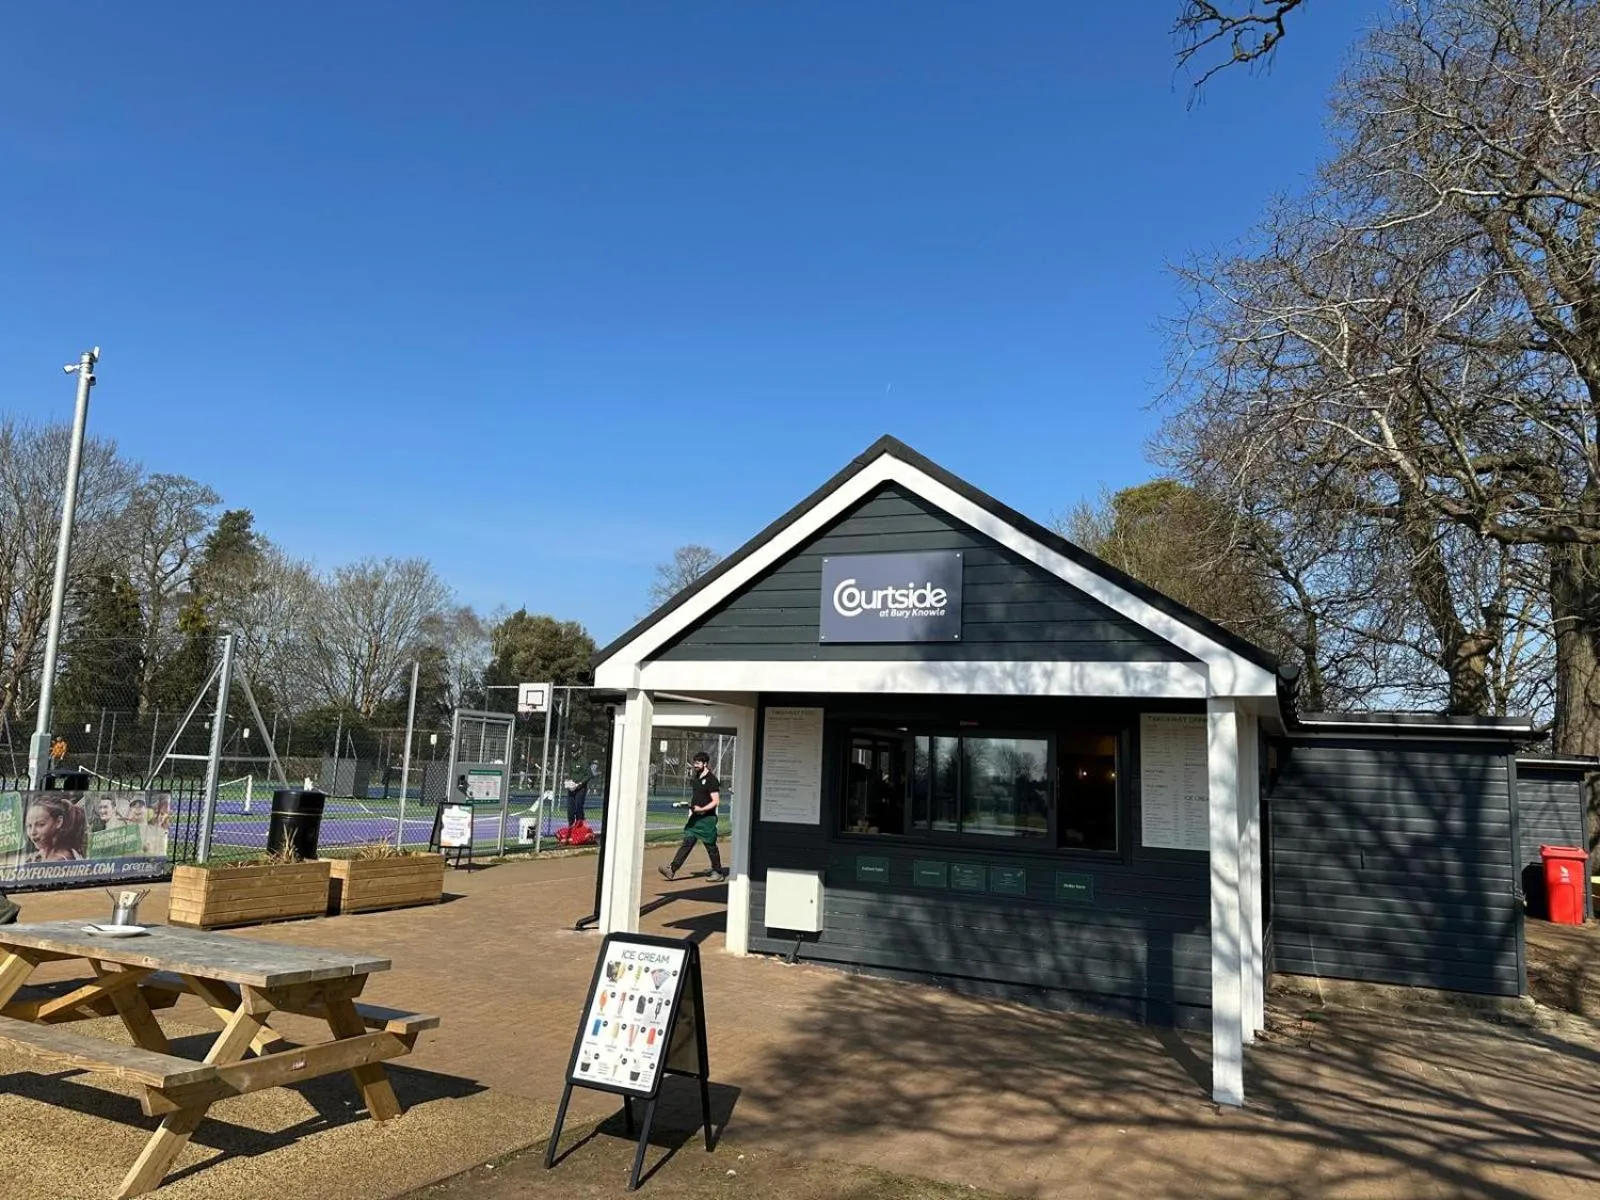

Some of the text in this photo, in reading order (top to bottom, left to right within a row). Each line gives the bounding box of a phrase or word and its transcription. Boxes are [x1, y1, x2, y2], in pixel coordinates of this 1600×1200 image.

[833, 578, 947, 618] Courtside
[879, 608, 946, 619] at Bury Knowle
[621, 950, 670, 964] ICE CREAM
